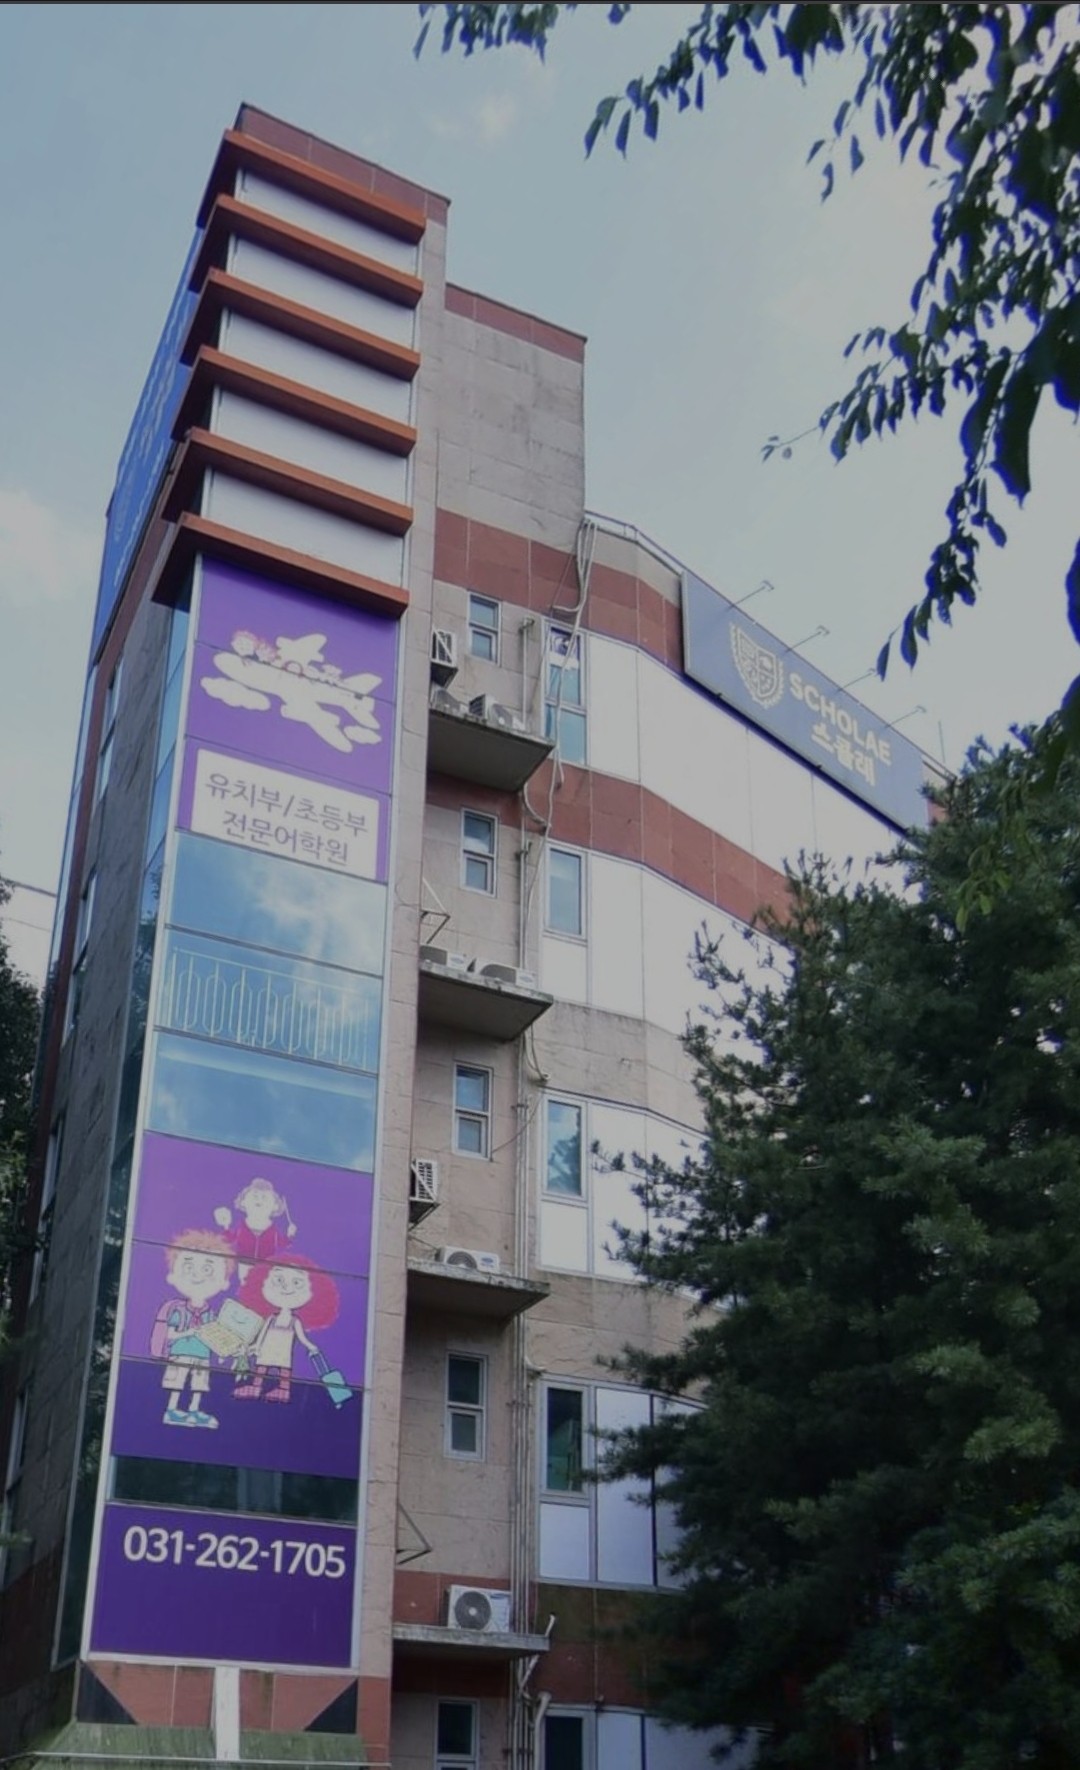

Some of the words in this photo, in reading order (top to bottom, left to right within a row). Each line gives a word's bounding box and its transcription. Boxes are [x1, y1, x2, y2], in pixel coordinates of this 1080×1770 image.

[789, 672, 892, 766] SCHOLAE
[205, 773, 368, 838] 유치부/초등부
[222, 810, 348, 867] 전문어학원
[123, 1526, 346, 1578] 031-262-1705
